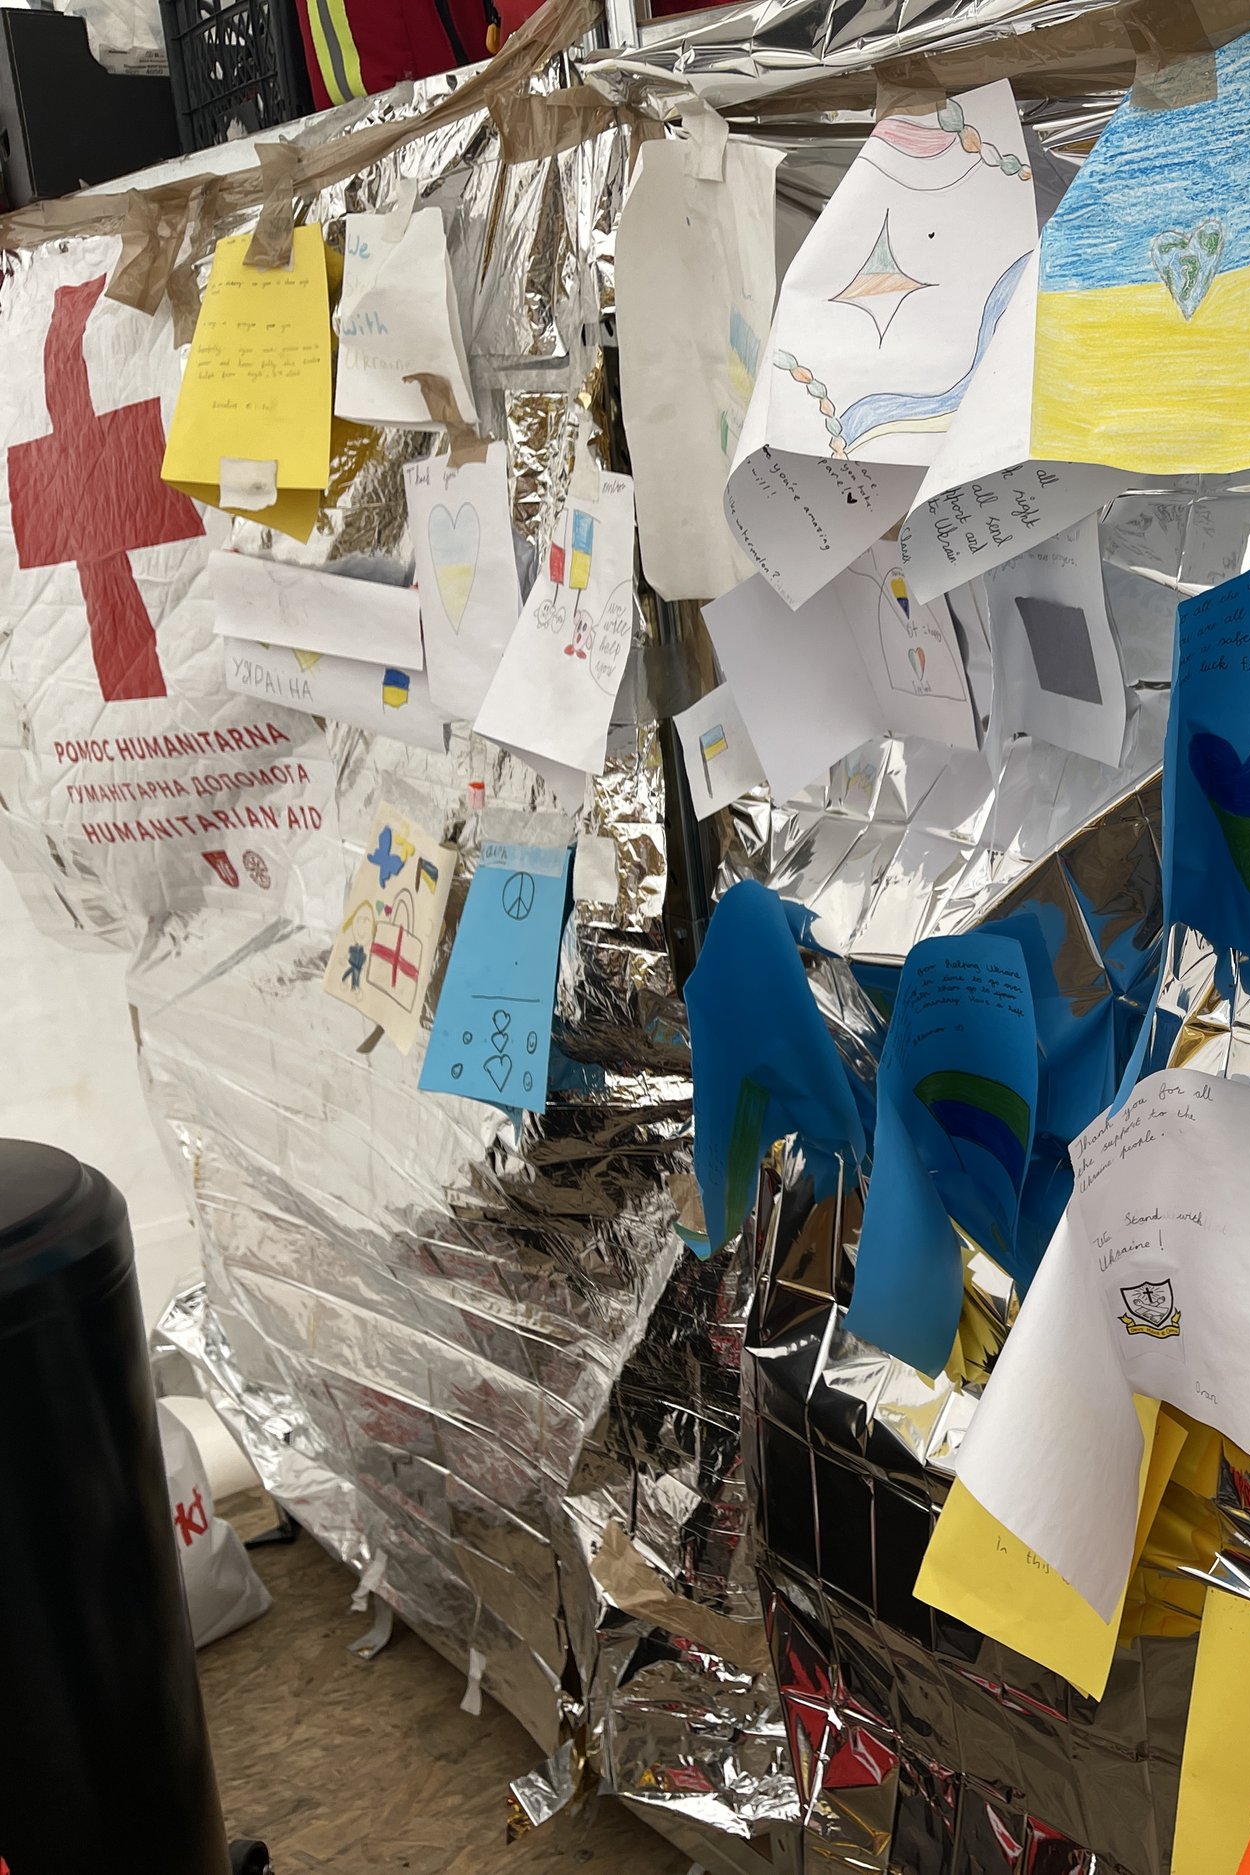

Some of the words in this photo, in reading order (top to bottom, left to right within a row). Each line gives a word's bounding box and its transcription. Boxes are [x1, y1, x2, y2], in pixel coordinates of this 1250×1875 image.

[941, 487, 972, 524] pport
[54, 740, 115, 764] POMOC
[115, 722, 291, 762] HUMANITARNA
[67, 778, 190, 804] ГУМАНІТАРНА
[191, 763, 311, 798] ДОПОМОГА
[81, 805, 279, 845] HUMANITARIAN
[288, 805, 322, 831] AID
[1123, 1098, 1147, 1122] you
[1158, 1082, 1185, 1100] for
[1193, 1084, 1213, 1101] all
[1102, 1117, 1142, 1152] support
[1148, 1108, 1167, 1120] to
[1177, 1104, 1196, 1121] the
